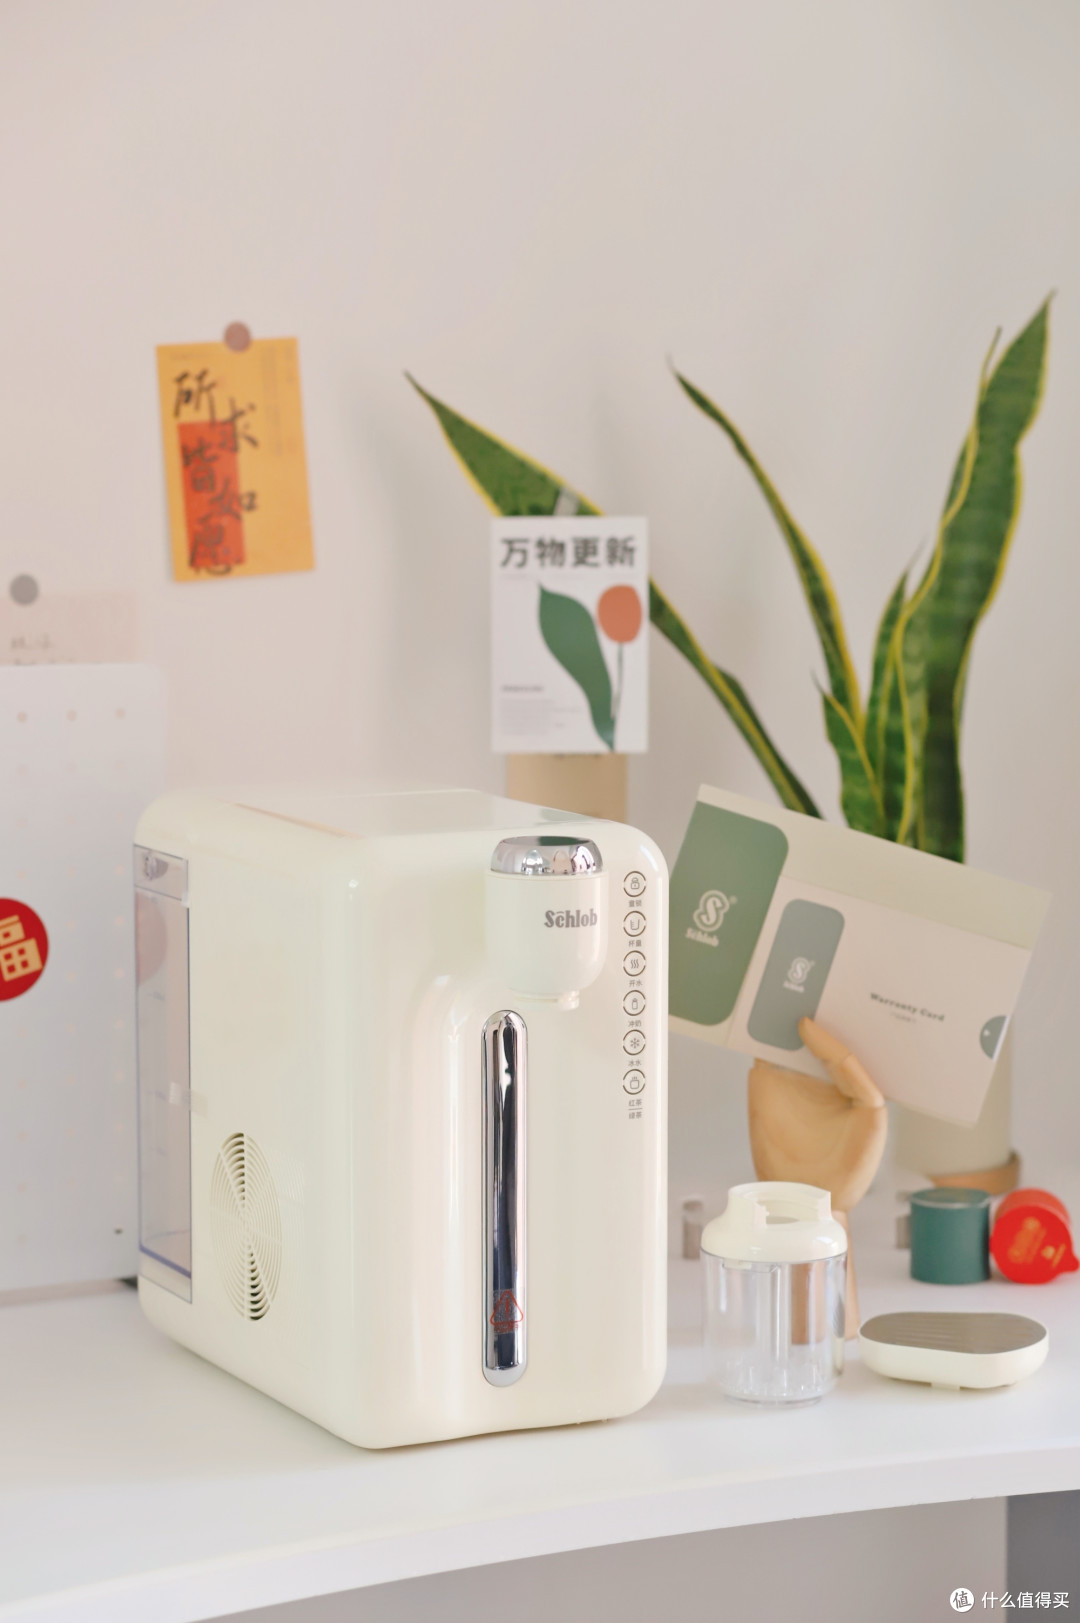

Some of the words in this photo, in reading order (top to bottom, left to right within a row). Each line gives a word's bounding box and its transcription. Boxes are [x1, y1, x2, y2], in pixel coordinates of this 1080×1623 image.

[500, 536, 638, 569] 万物更新
[629, 979, 643, 988] 开水
[870, 992, 918, 1015] Warranty
[919, 1007, 945, 1022] Card
[627, 1019, 642, 1028] 冲奶
[628, 1059, 642, 1067] 冰水
[628, 1098, 643, 1107] 红茶
[628, 1111, 643, 1120] 绿茶
